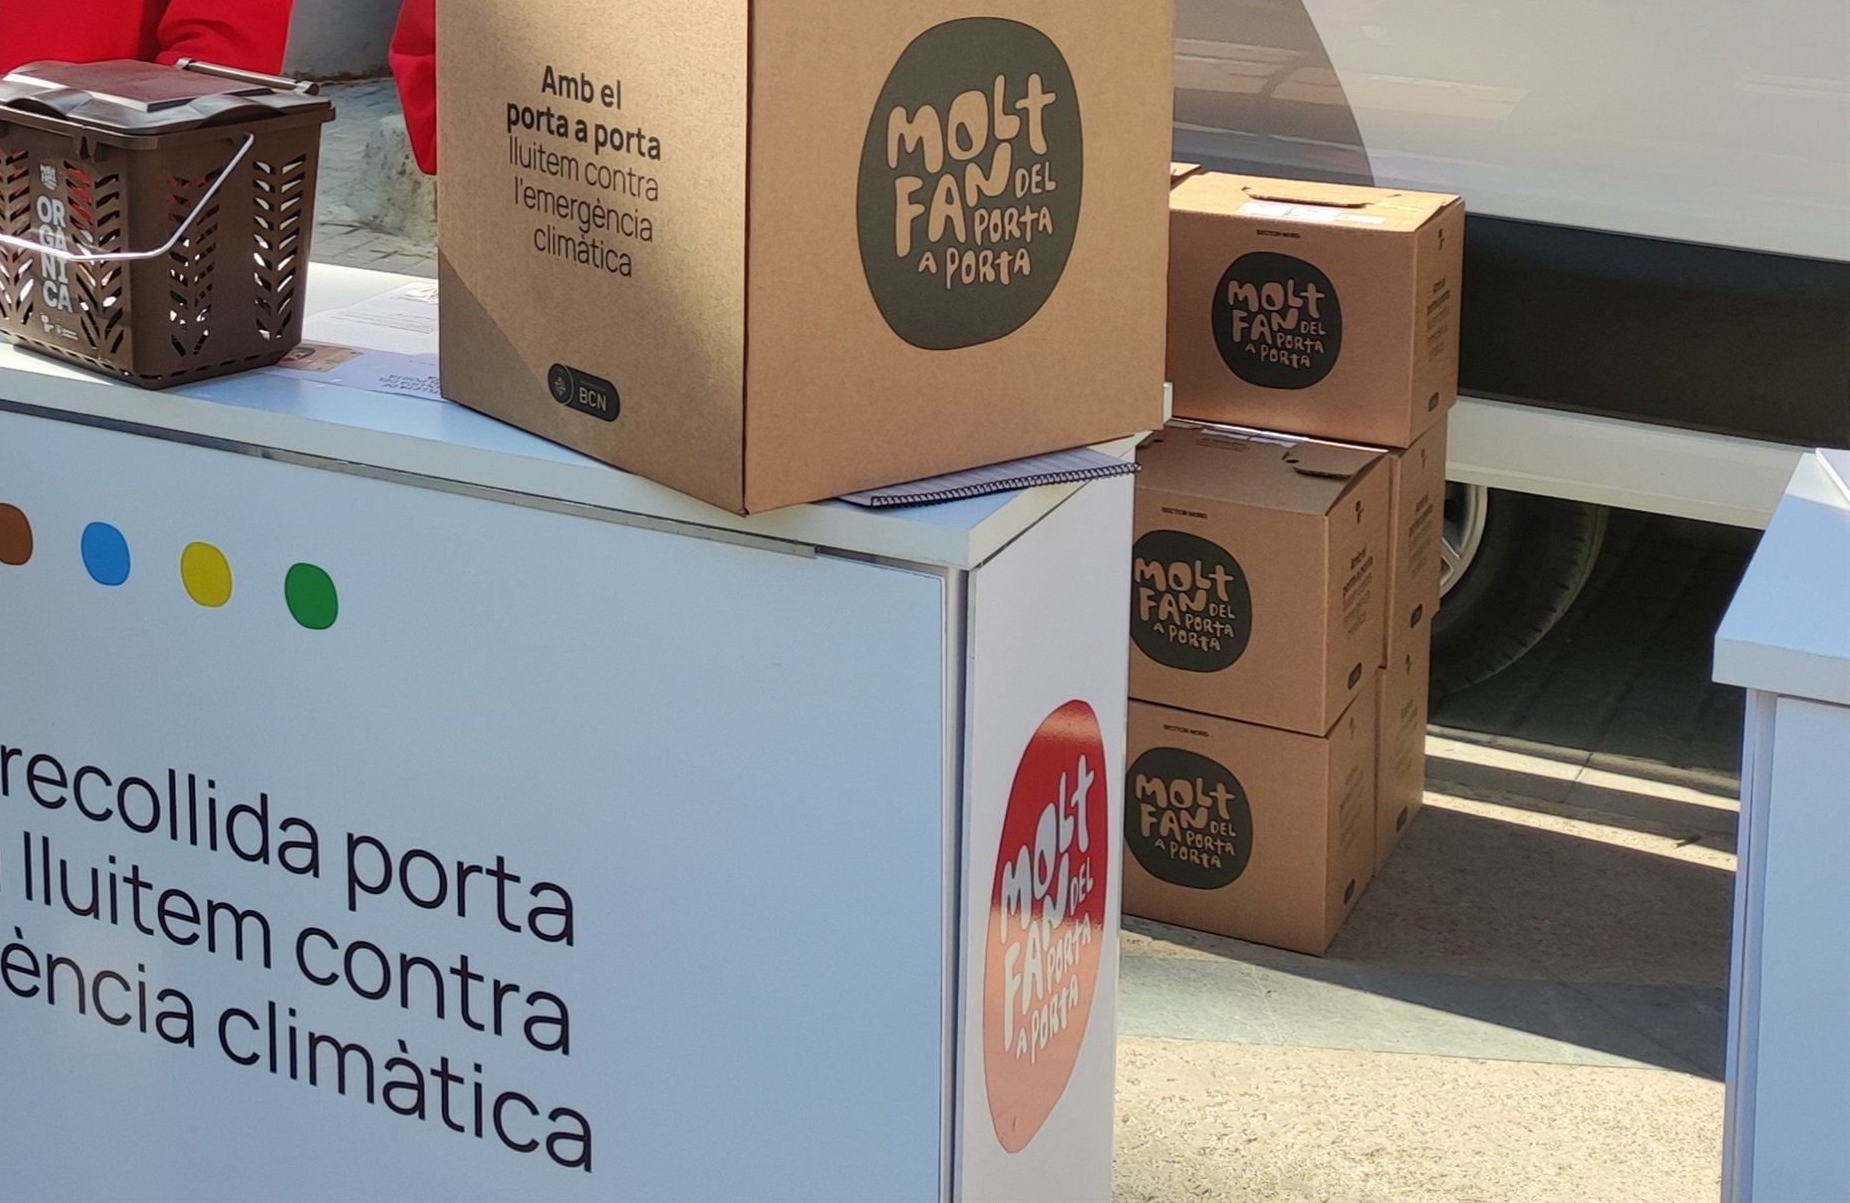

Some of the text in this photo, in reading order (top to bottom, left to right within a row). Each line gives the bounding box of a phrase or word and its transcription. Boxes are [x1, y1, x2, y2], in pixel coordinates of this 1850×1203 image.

[541, 65, 621, 110] Amb el
[506, 102, 661, 161] porta a porta
[887, 73, 1056, 173] MOLT
[509, 135, 658, 202] lluitem contra
[514, 176, 653, 243] l'emergència
[895, 141, 1057, 257] FAN DEL
[973, 204, 1054, 246] PORTA
[533, 224, 632, 278] climàtica
[918, 247, 1031, 290] A PORTA
[1228, 279, 1325, 318] MOLT
[1232, 308, 1326, 344] FAN DEL
[1276, 332, 1324, 353] PORTA
[1245, 343, 1311, 369] A PORTA
[578, 386, 607, 412] BCN
[1134, 557, 1234, 602] MOLT
[1139, 586, 1235, 626] FAN DEL
[1185, 613, 1233, 637] PORTA
[1153, 622, 1221, 651] A PORTA
[1135, 773, 1235, 820] MOLT
[0, 742, 321, 880] recollida
[345, 830, 575, 946] porta
[1140, 802, 1237, 842] FAN DEL
[1186, 830, 1235, 856] PORTA
[1000, 753, 1095, 945] MOLT
[1154, 838, 1222, 869] A PORTA
[22, 829, 272, 970] lluitem
[294, 925, 571, 1056] contra
[1004, 852, 1094, 1052] FAN DEL
[1047, 911, 1092, 995] PORTA
[1016, 974, 1079, 1065] A PORTA
[216, 999, 593, 1173] climàtica
